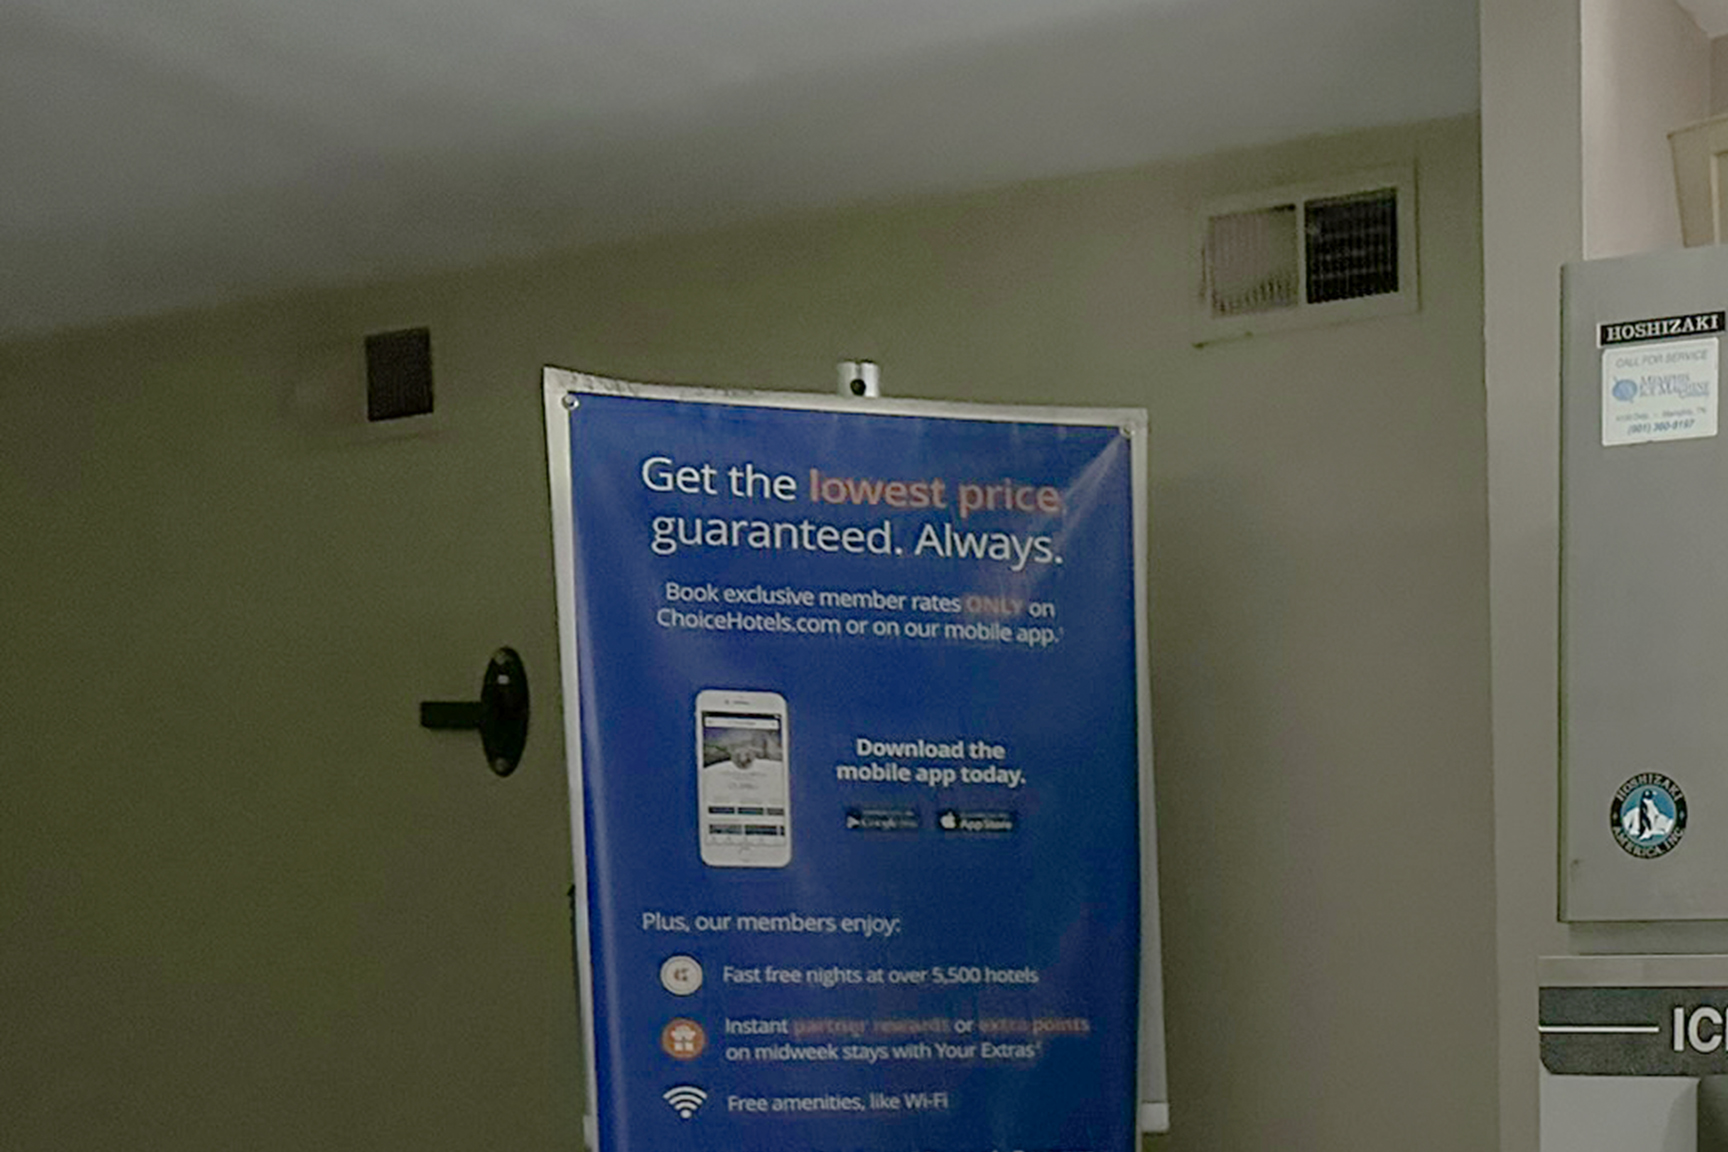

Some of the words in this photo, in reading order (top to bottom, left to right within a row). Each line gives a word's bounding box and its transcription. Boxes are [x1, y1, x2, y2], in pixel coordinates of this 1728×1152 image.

[1606, 315, 1718, 341] HOSHIZAKI
[642, 456, 717, 496] Get
[728, 463, 797, 500] the
[809, 468, 946, 509] lowest
[958, 478, 1064, 517] price
[651, 514, 902, 555] guaranteed.
[915, 521, 1064, 572] Always.
[666, 582, 718, 603] Book
[724, 583, 814, 607] exclusive
[820, 588, 905, 612] member
[911, 592, 960, 614] rates
[965, 595, 1024, 615] ONLY
[1029, 600, 1054, 618] on
[657, 608, 841, 635] ChoiceHotels.com
[846, 618, 867, 635] or
[873, 619, 899, 637] on
[904, 622, 939, 638] our
[944, 619, 1013, 643] mobile
[856, 738, 964, 760] Download
[969, 739, 1006, 760] the
[836, 762, 911, 783] mobile
[916, 766, 956, 787] app
[960, 764, 1026, 788] today.
[1616, 774, 1683, 801] HOSHIZAKI
[642, 912, 690, 934] Plus,
[695, 914, 731, 932] our
[737, 913, 836, 933] members
[841, 914, 901, 937] enjoy:
[723, 966, 761, 983] Fast
[765, 966, 800, 983] free
[806, 966, 862, 988] nights
[866, 968, 883, 983] at
[888, 970, 927, 983] over
[932, 966, 981, 987] 5,500
[984, 966, 1038, 983] hotels
[726, 1018, 788, 1036] Instant
[954, 1019, 973, 1034] or
[1031, 1016, 1089, 1038] points
[726, 1045, 750, 1061] on
[755, 1041, 838, 1061] midweek
[842, 1044, 889, 1065] stays
[893, 1041, 932, 1059] with
[936, 1041, 976, 1059] Your
[728, 1095, 767, 1112] Free
[771, 1095, 866, 1114] amenities,
[870, 1093, 899, 1110] like
[904, 1092, 948, 1110] Wi-Fi
